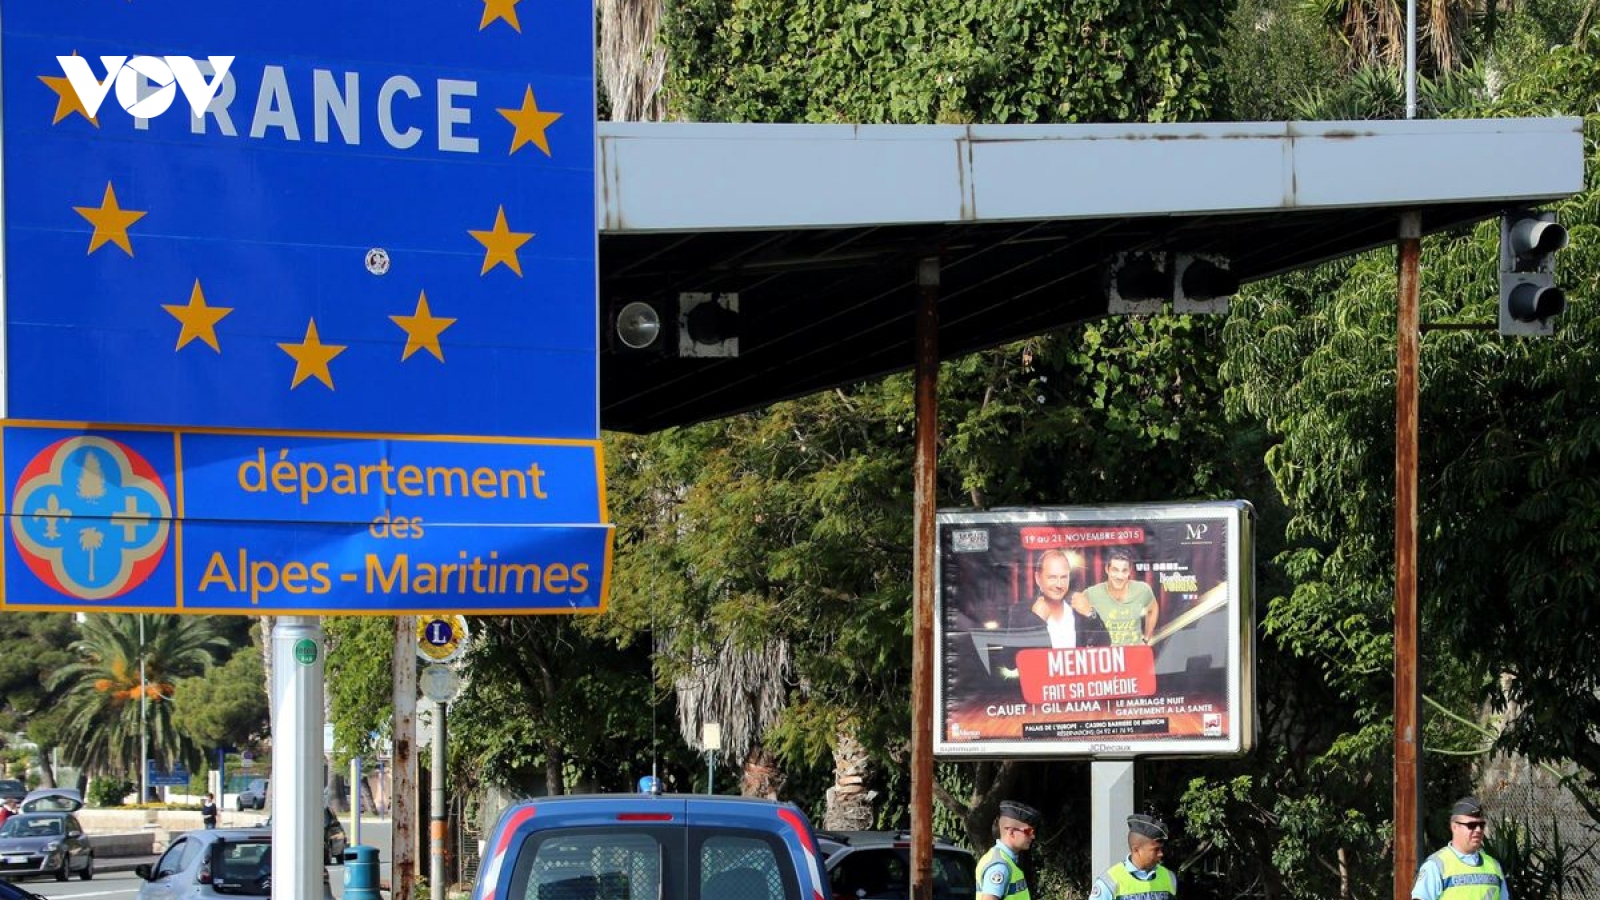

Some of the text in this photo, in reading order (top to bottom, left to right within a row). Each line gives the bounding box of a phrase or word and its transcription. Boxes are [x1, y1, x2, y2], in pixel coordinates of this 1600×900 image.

[238, 447, 547, 504] département
[370, 508, 424, 538] des
[1065, 532, 1115, 541] NOVEMBRE
[1118, 530, 1139, 539] 2015
[198, 548, 332, 604] Alpes
[365, 551, 589, 594] Maritimes
[1048, 646, 1125, 677] MENTON
[1043, 675, 1138, 700] FAIT SA COMÉDIE
[986, 700, 1101, 716] CAUET GIL ALMA
[1116, 706, 1165, 715] GRAVEMENT
[1127, 698, 1164, 706] MARIAGE
[1166, 696, 1184, 704] NUIT
[1088, 743, 1131, 752] JCDecaux
